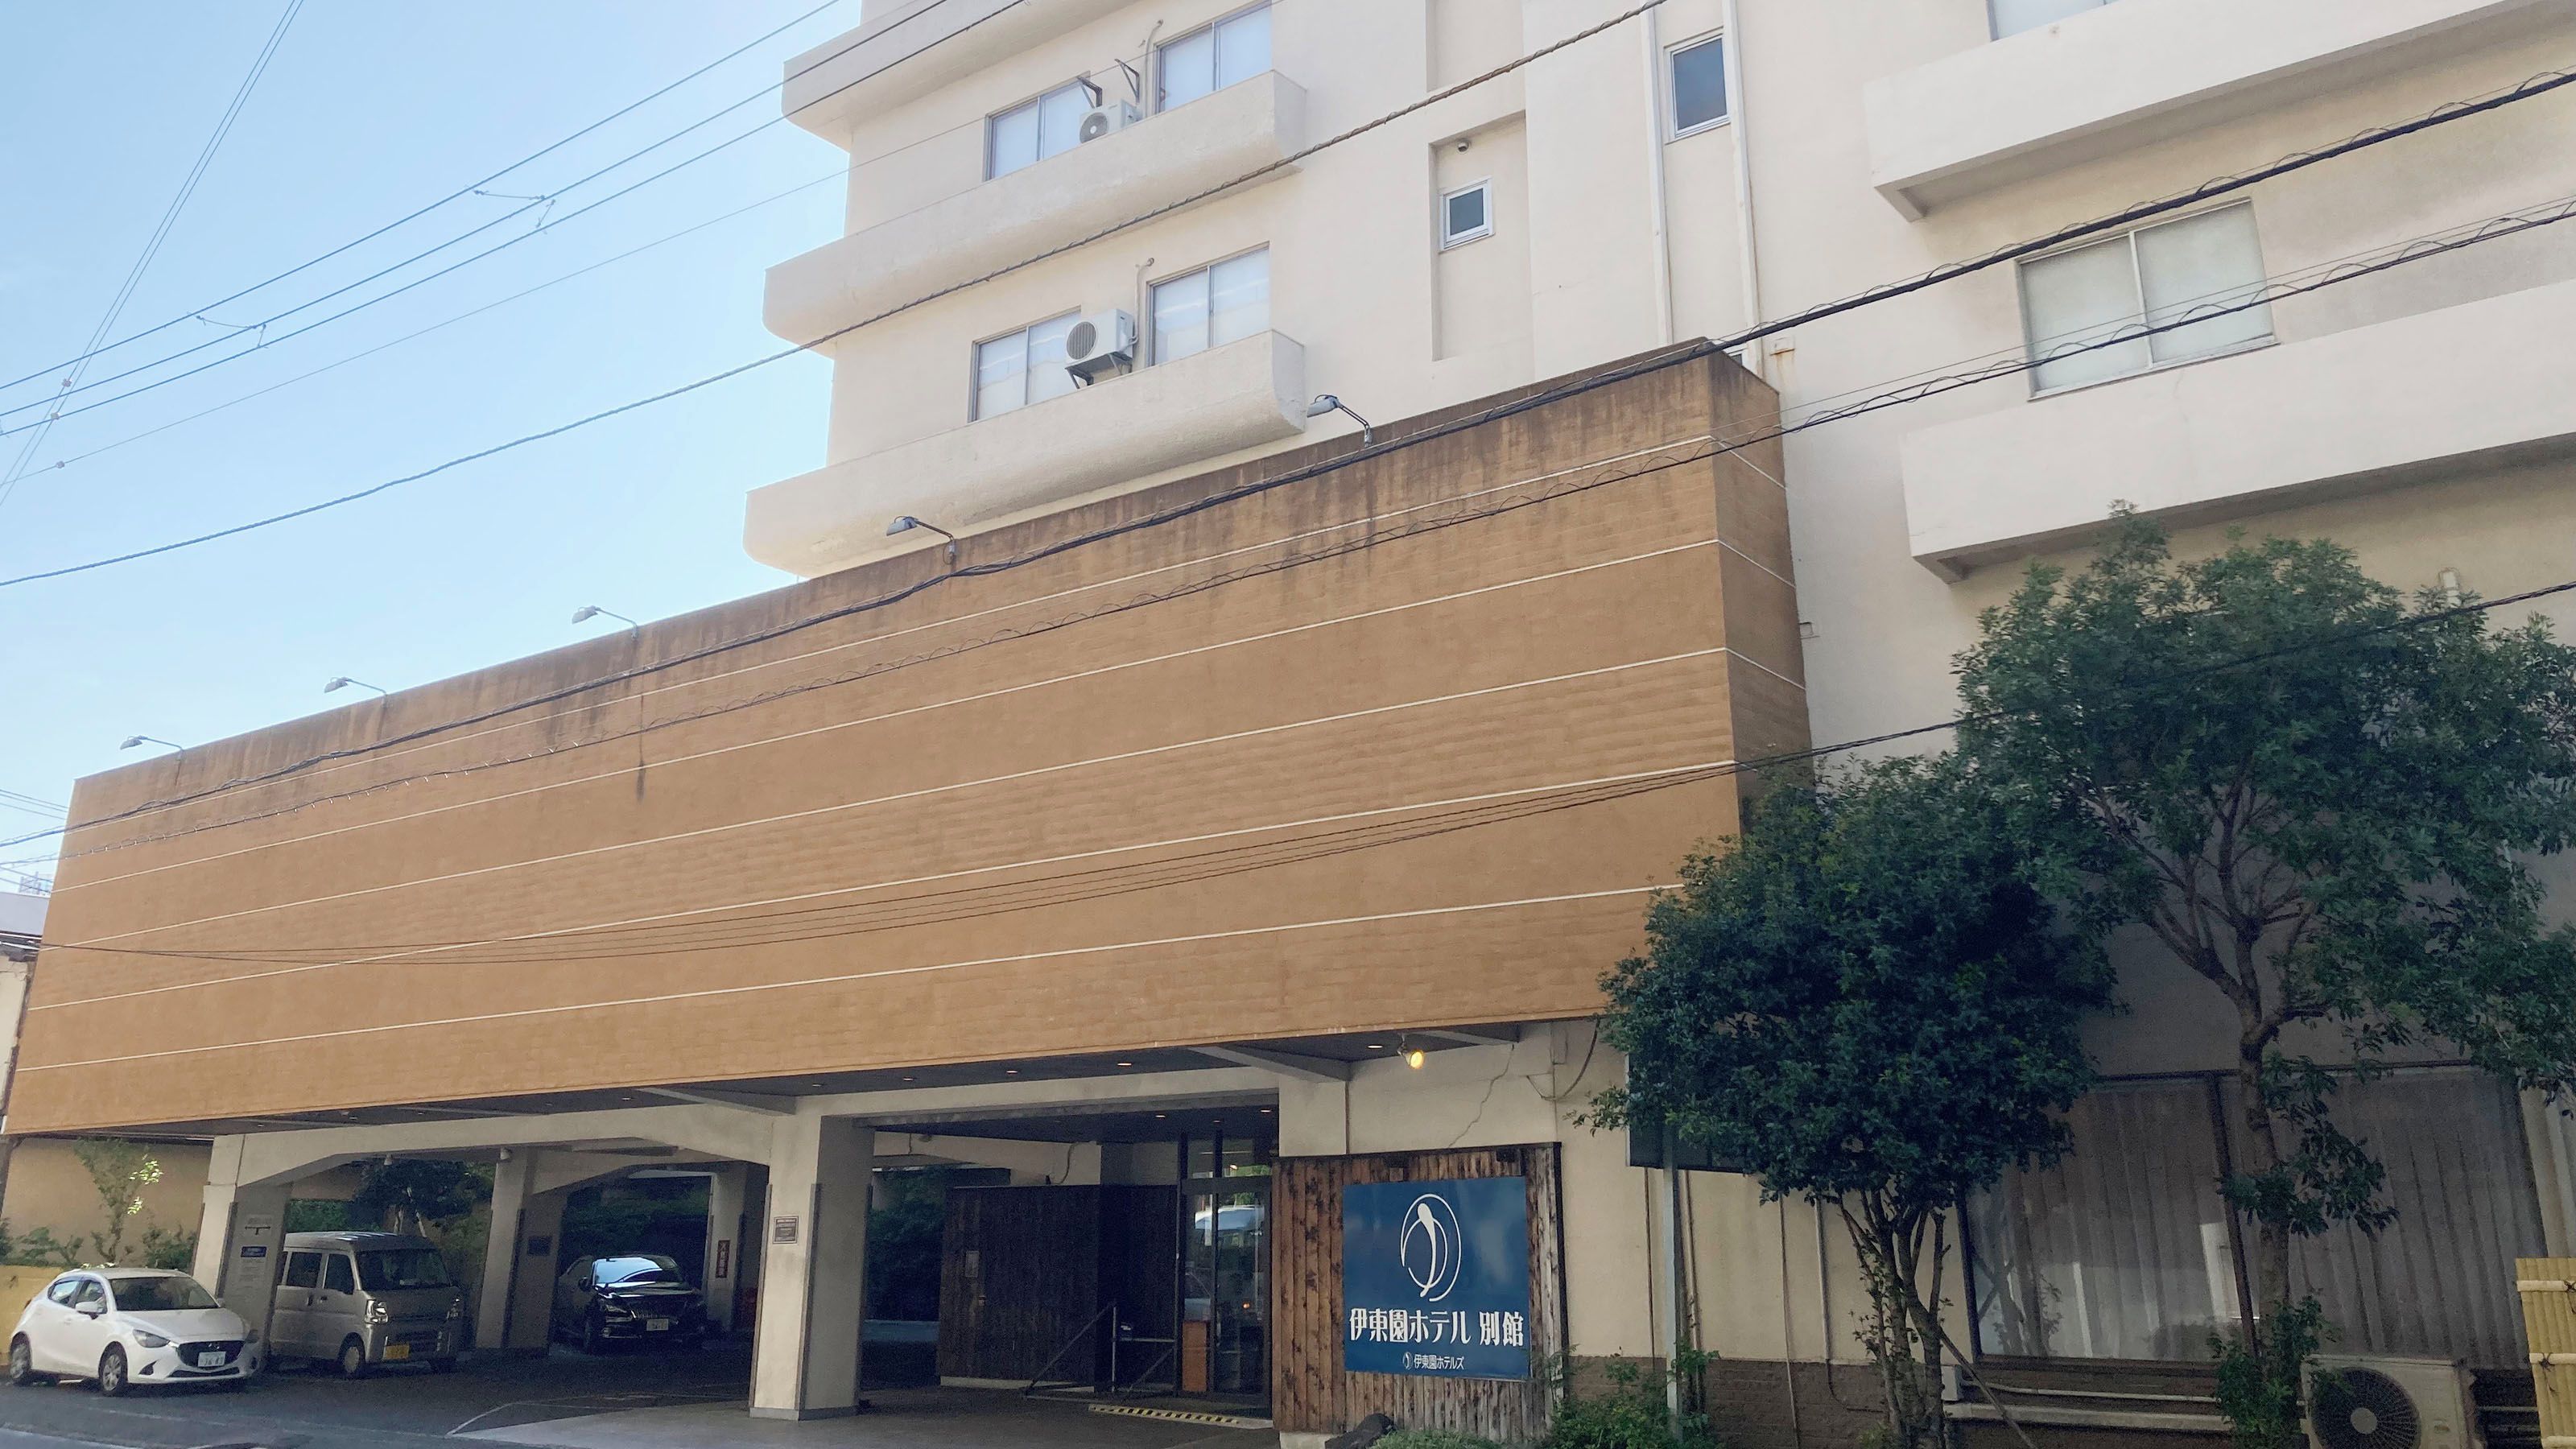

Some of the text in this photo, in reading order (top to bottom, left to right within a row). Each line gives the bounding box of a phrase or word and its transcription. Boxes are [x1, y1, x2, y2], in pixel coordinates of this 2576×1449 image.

[1349, 1308, 1524, 1347] 伊東園ホテル 別館
[1414, 1354, 1464, 1370] 伊東園ホテルズ
